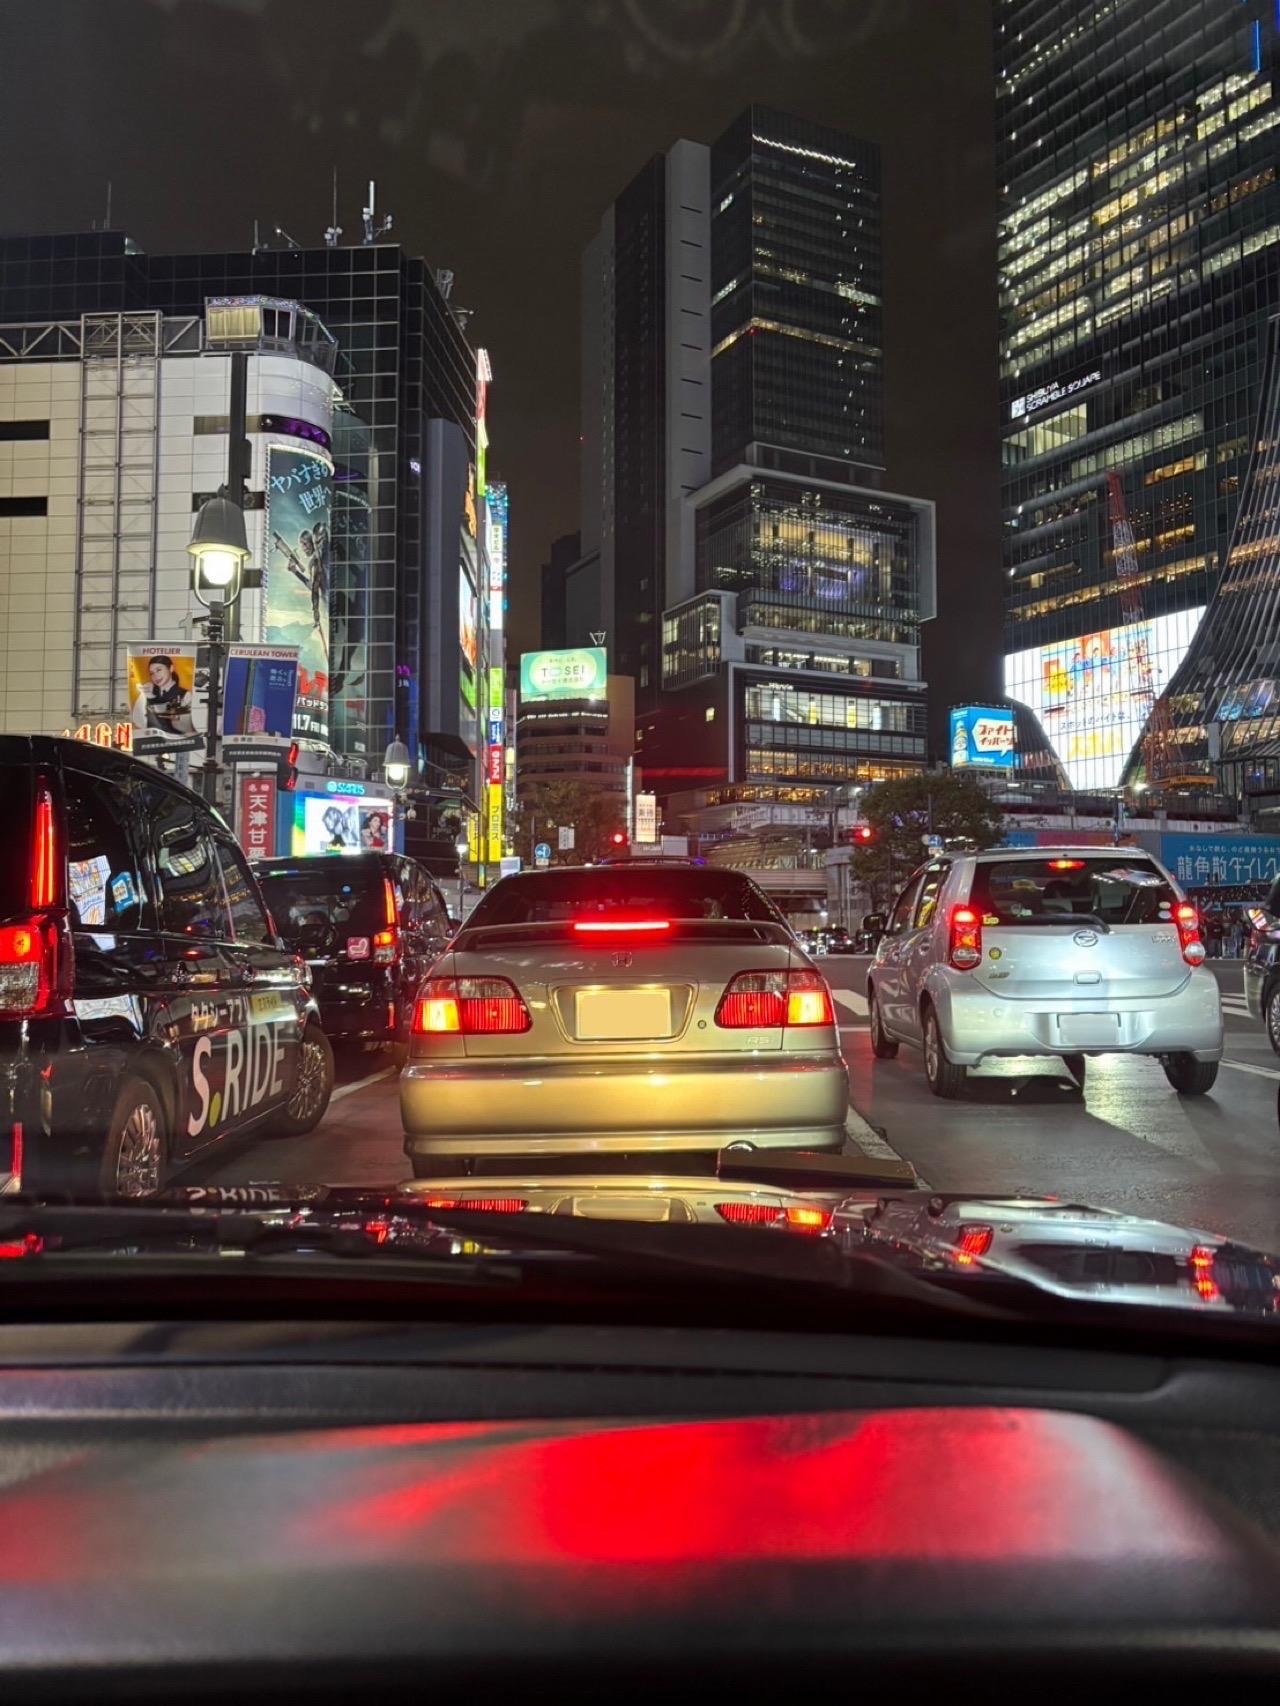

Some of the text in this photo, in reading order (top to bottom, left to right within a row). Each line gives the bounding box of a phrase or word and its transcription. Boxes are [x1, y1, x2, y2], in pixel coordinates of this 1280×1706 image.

[1067, 370, 1101, 394] SQUARE
[142, 647, 181, 655] HOTELIER
[271, 649, 299, 658] TOWER
[187, 1022, 285, 1137] S.RIDE
